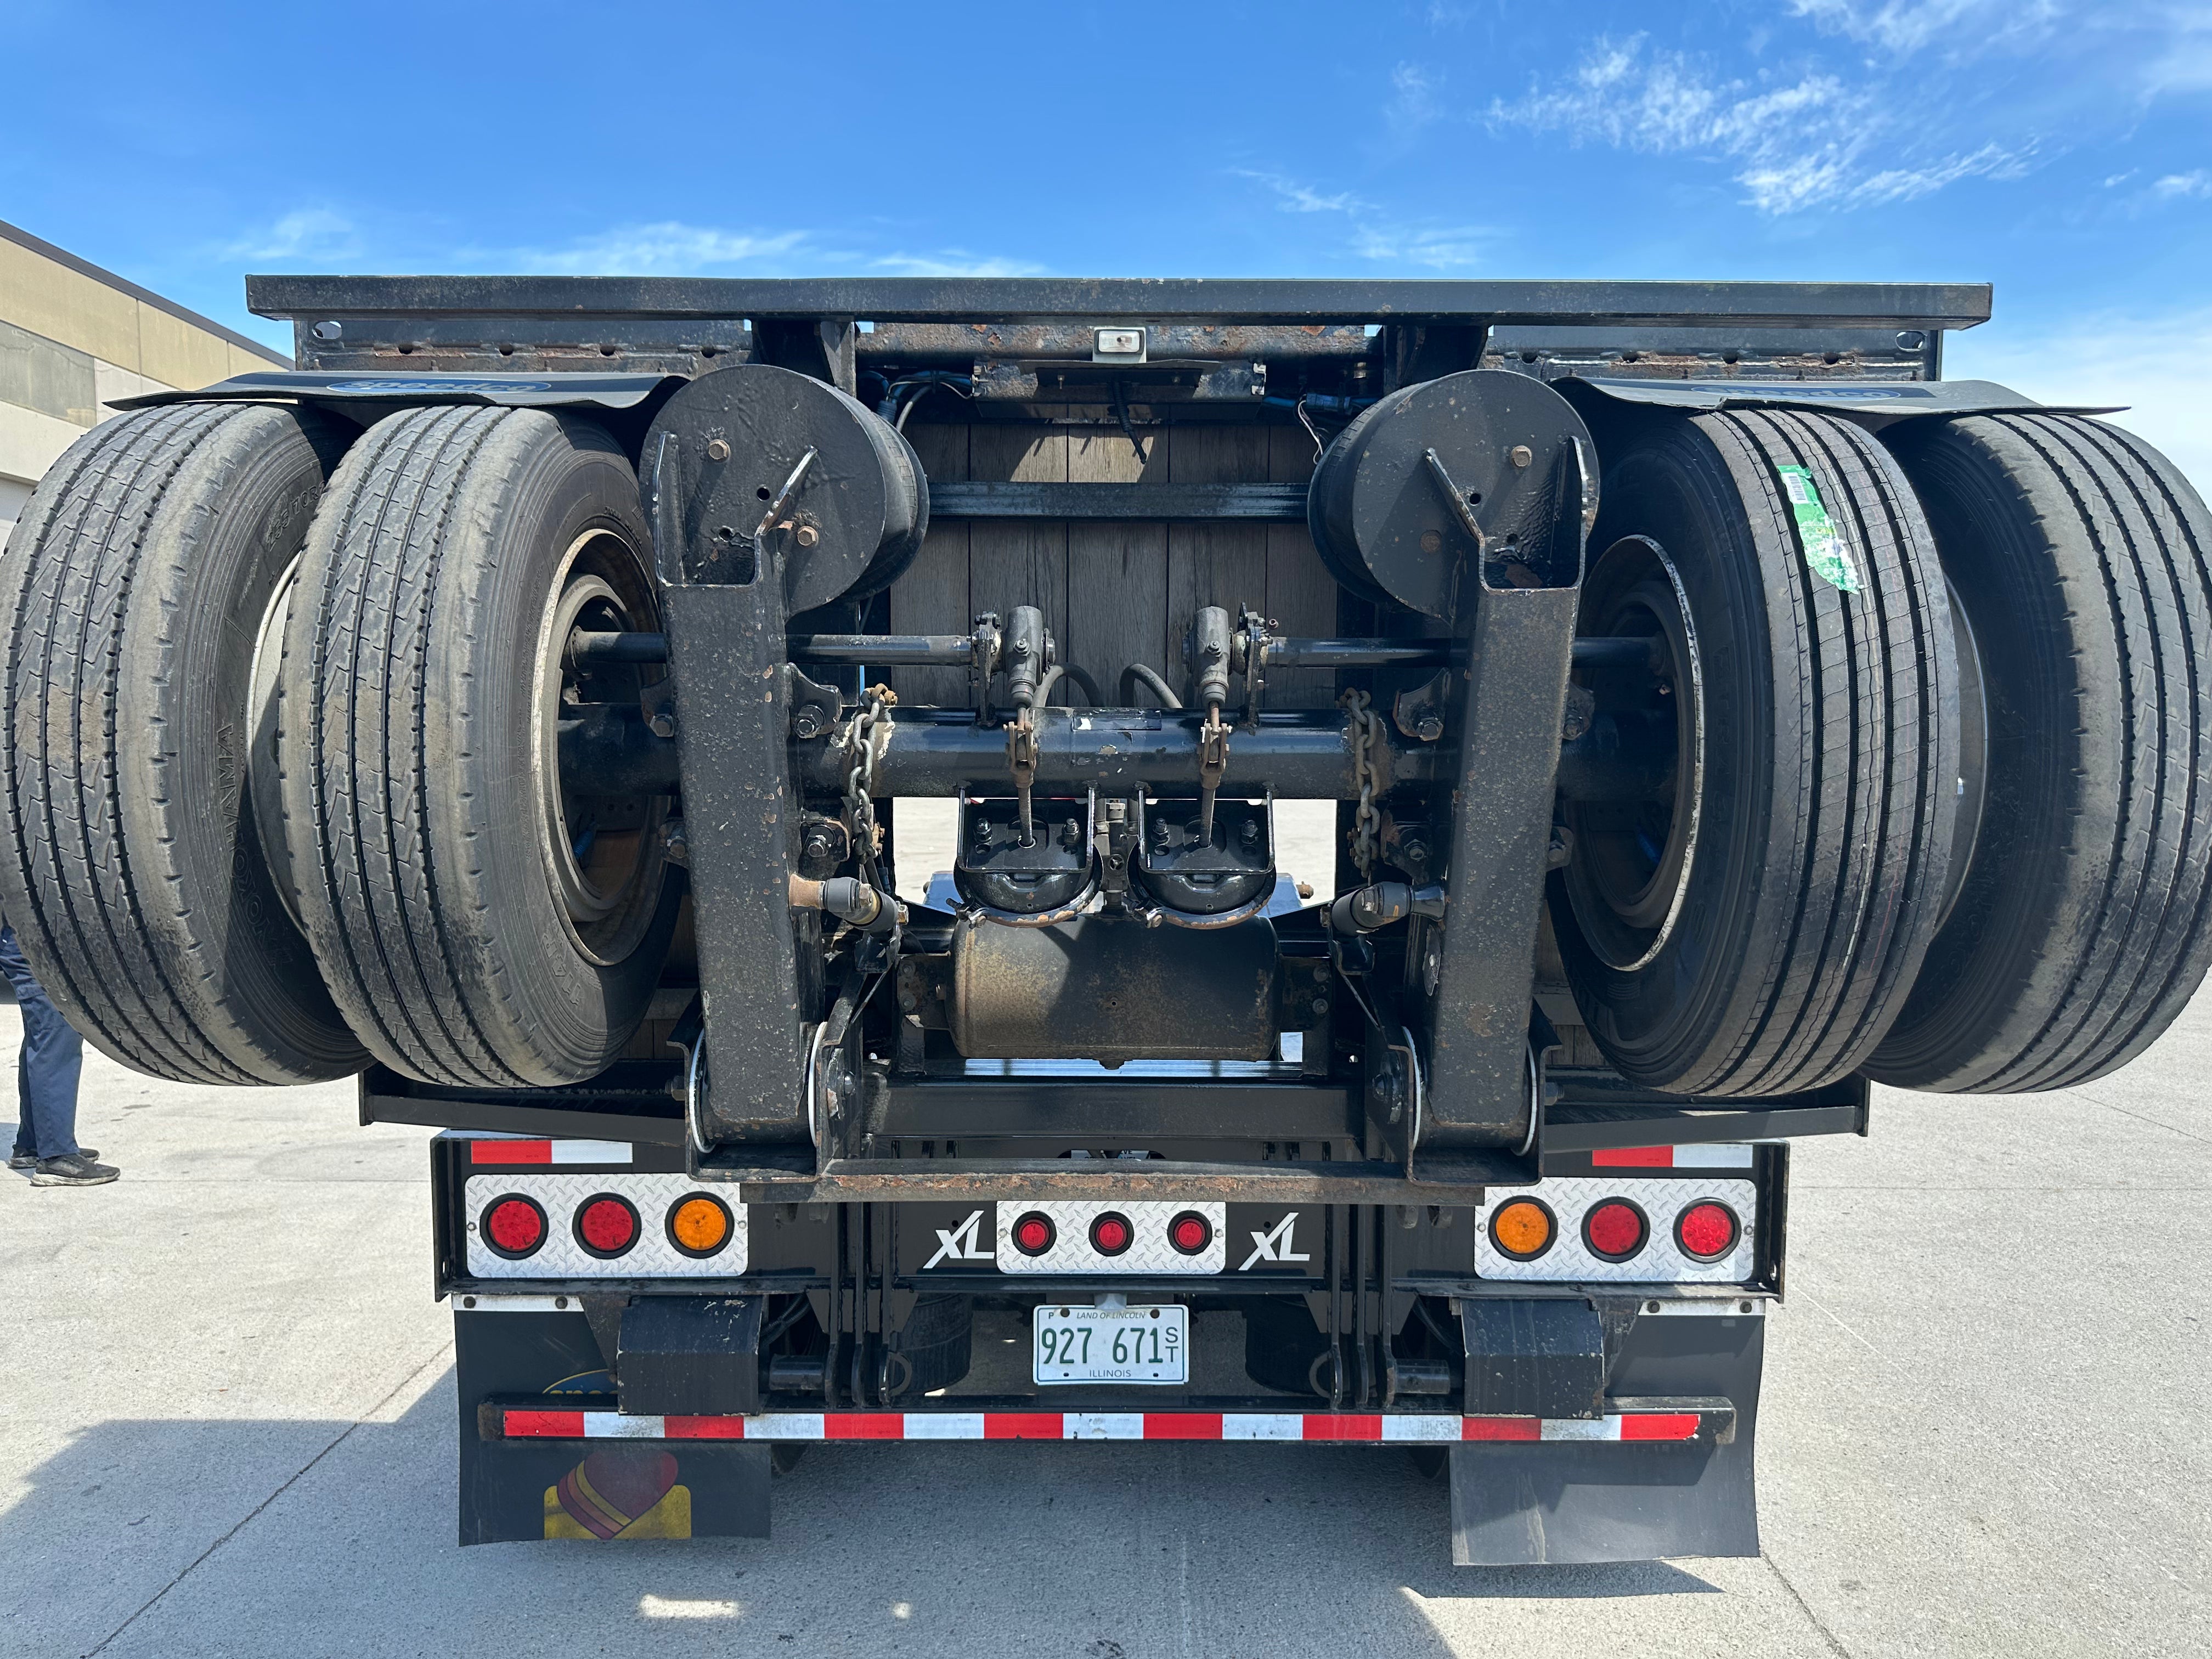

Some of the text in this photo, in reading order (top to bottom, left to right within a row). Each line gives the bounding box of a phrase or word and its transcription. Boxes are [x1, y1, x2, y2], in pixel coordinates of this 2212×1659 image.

[345, 382, 536, 391] speedco
[1704, 387, 1890, 397] speedco
[1041, 1327, 1164, 1364] 927 671
